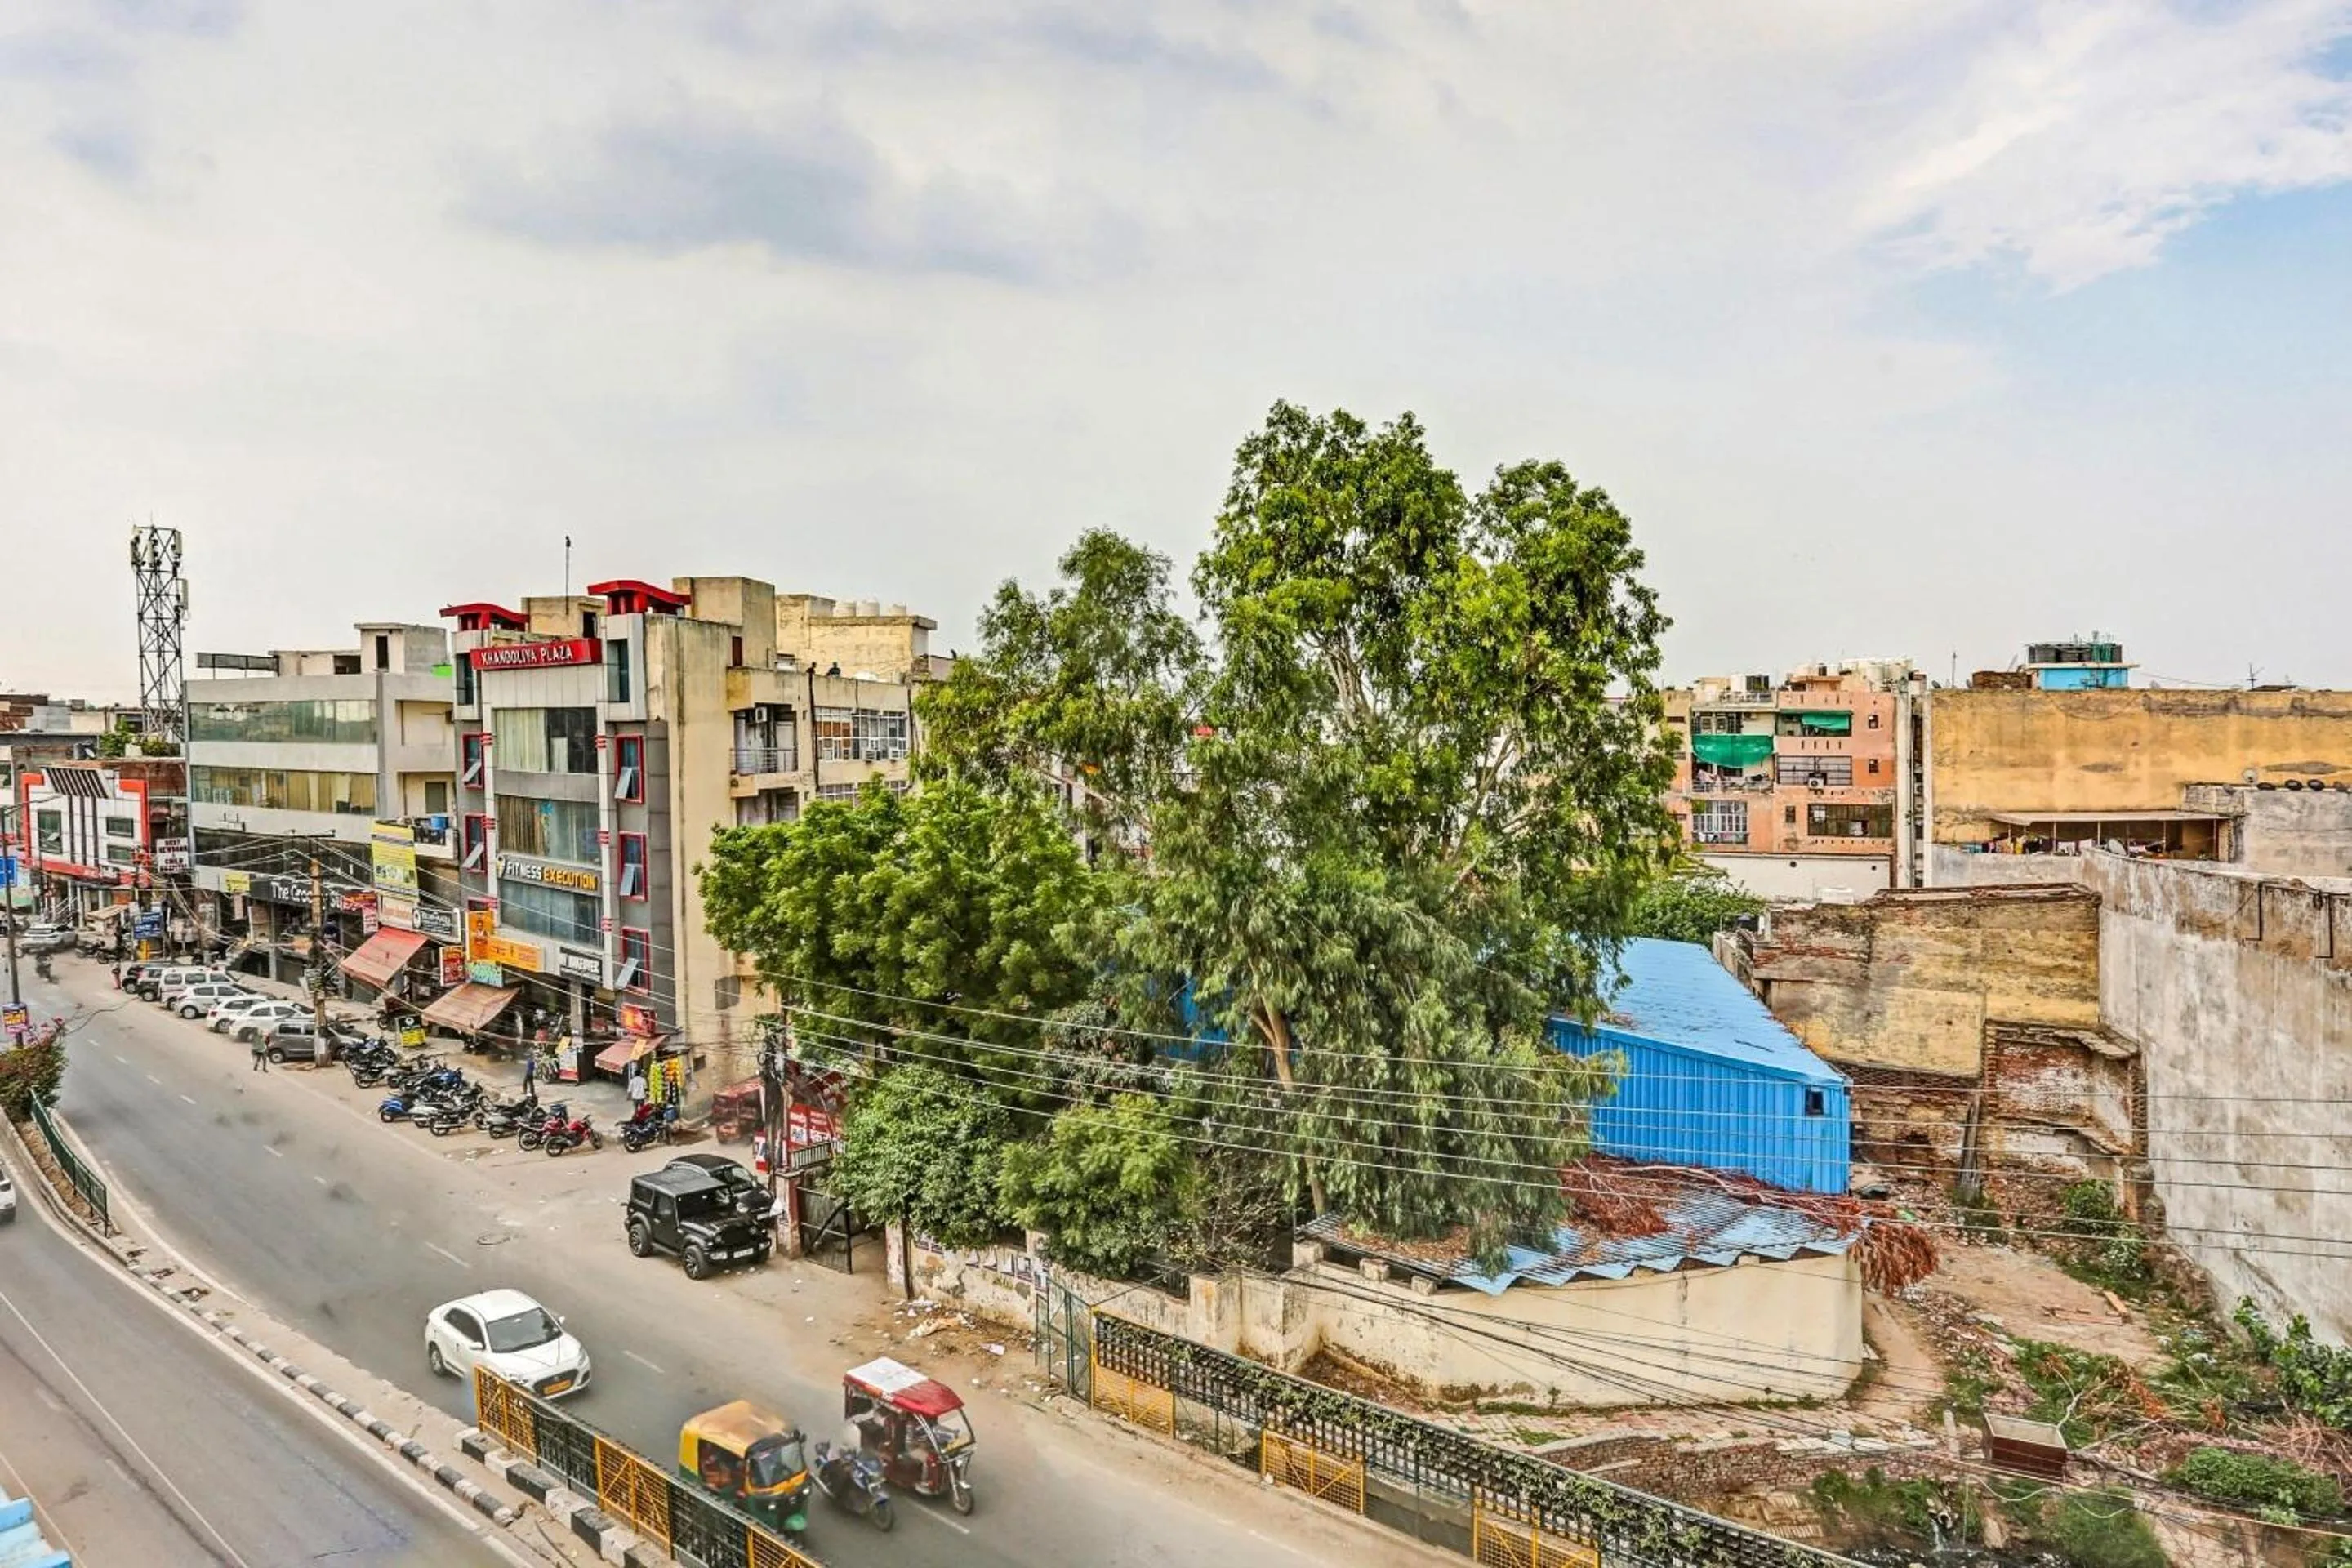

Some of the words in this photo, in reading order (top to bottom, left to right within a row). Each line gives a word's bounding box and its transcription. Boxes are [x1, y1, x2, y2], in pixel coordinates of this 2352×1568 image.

[540, 644, 573, 661] PLAZA
[506, 860, 542, 880] FITNESS
[543, 866, 597, 891] EXECUTION
[270, 881, 289, 899] The
